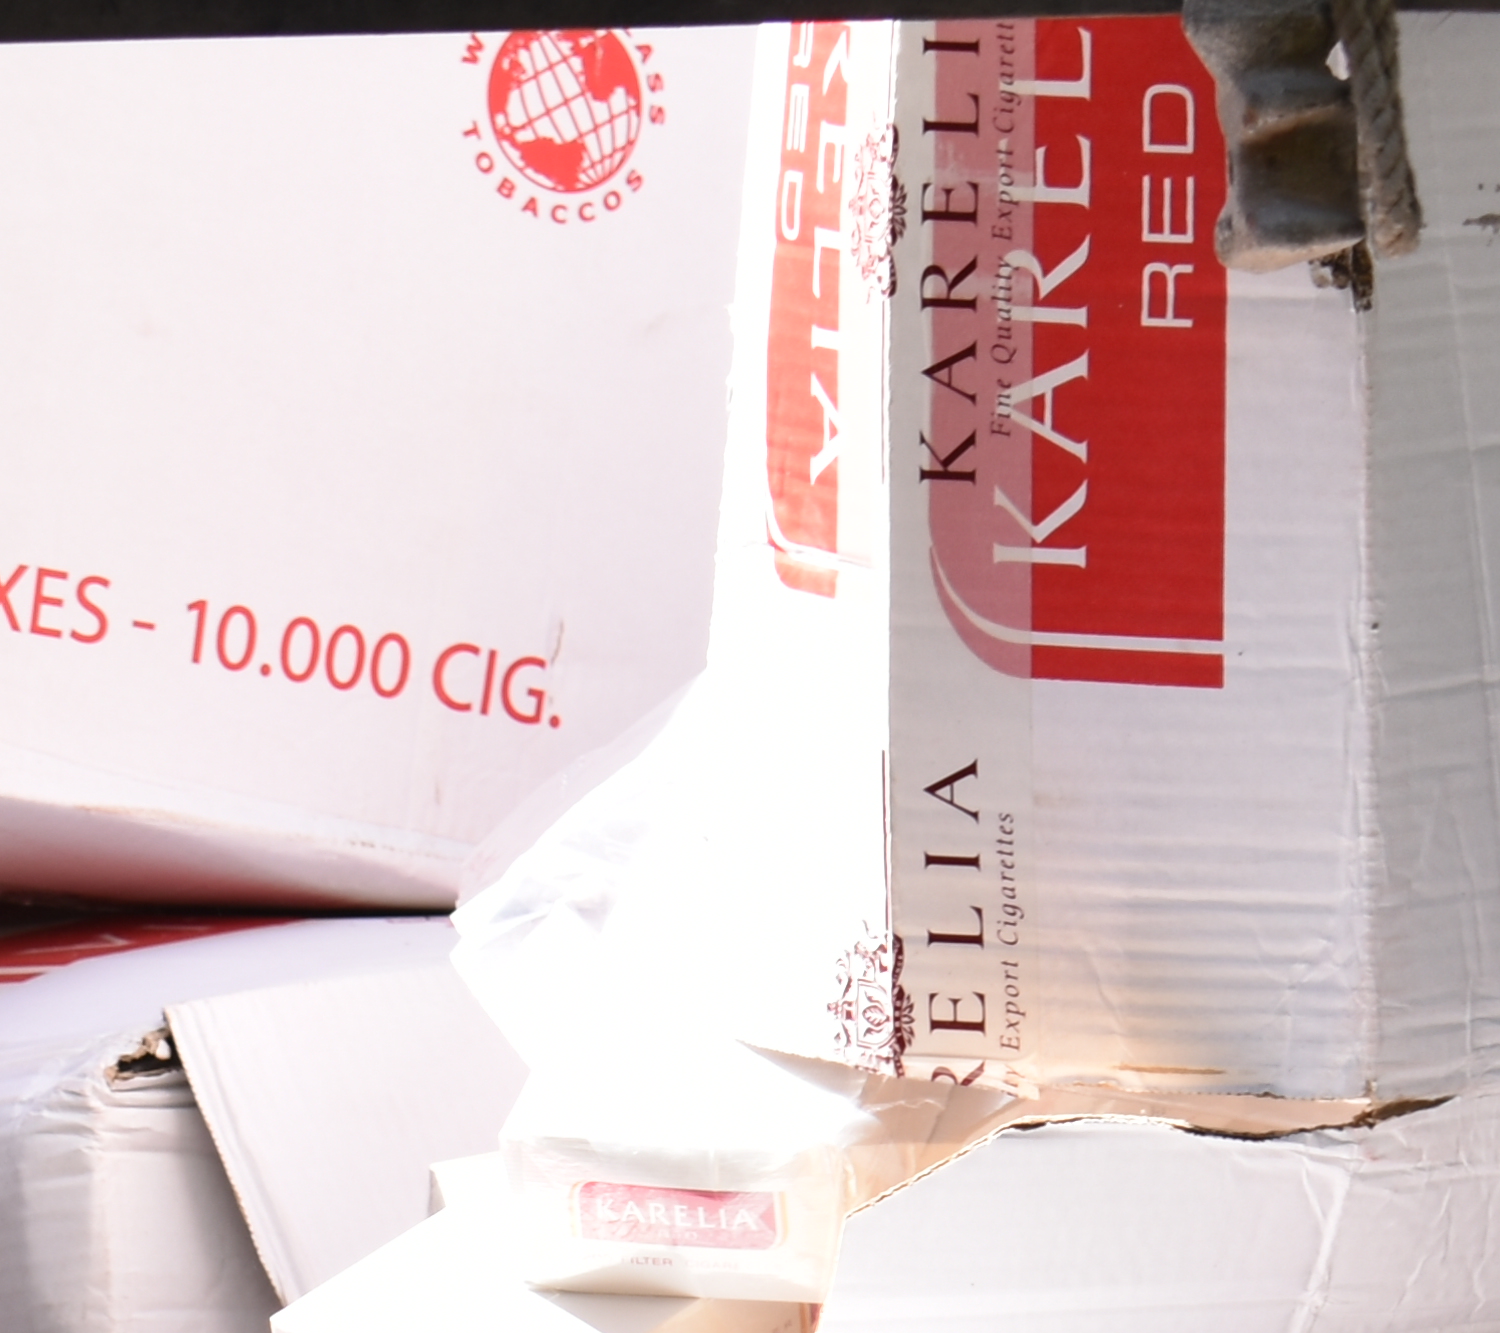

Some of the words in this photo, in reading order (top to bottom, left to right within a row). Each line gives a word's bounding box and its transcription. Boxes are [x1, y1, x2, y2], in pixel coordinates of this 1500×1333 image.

[627, 28, 667, 126] ASS
[460, 120, 645, 224] TOBACCOS
[990, 138, 1018, 243] Export
[1139, 83, 1196, 329] RED
[990, 254, 1018, 366] Quality
[989, 377, 1012, 439] Fine
[185, 598, 411, 700] 10.000
[432, 641, 563, 729] CIG.
[995, 811, 1025, 947] Cigarettes
[998, 960, 1027, 1052] Export
[594, 1197, 759, 1232] KARELIA
